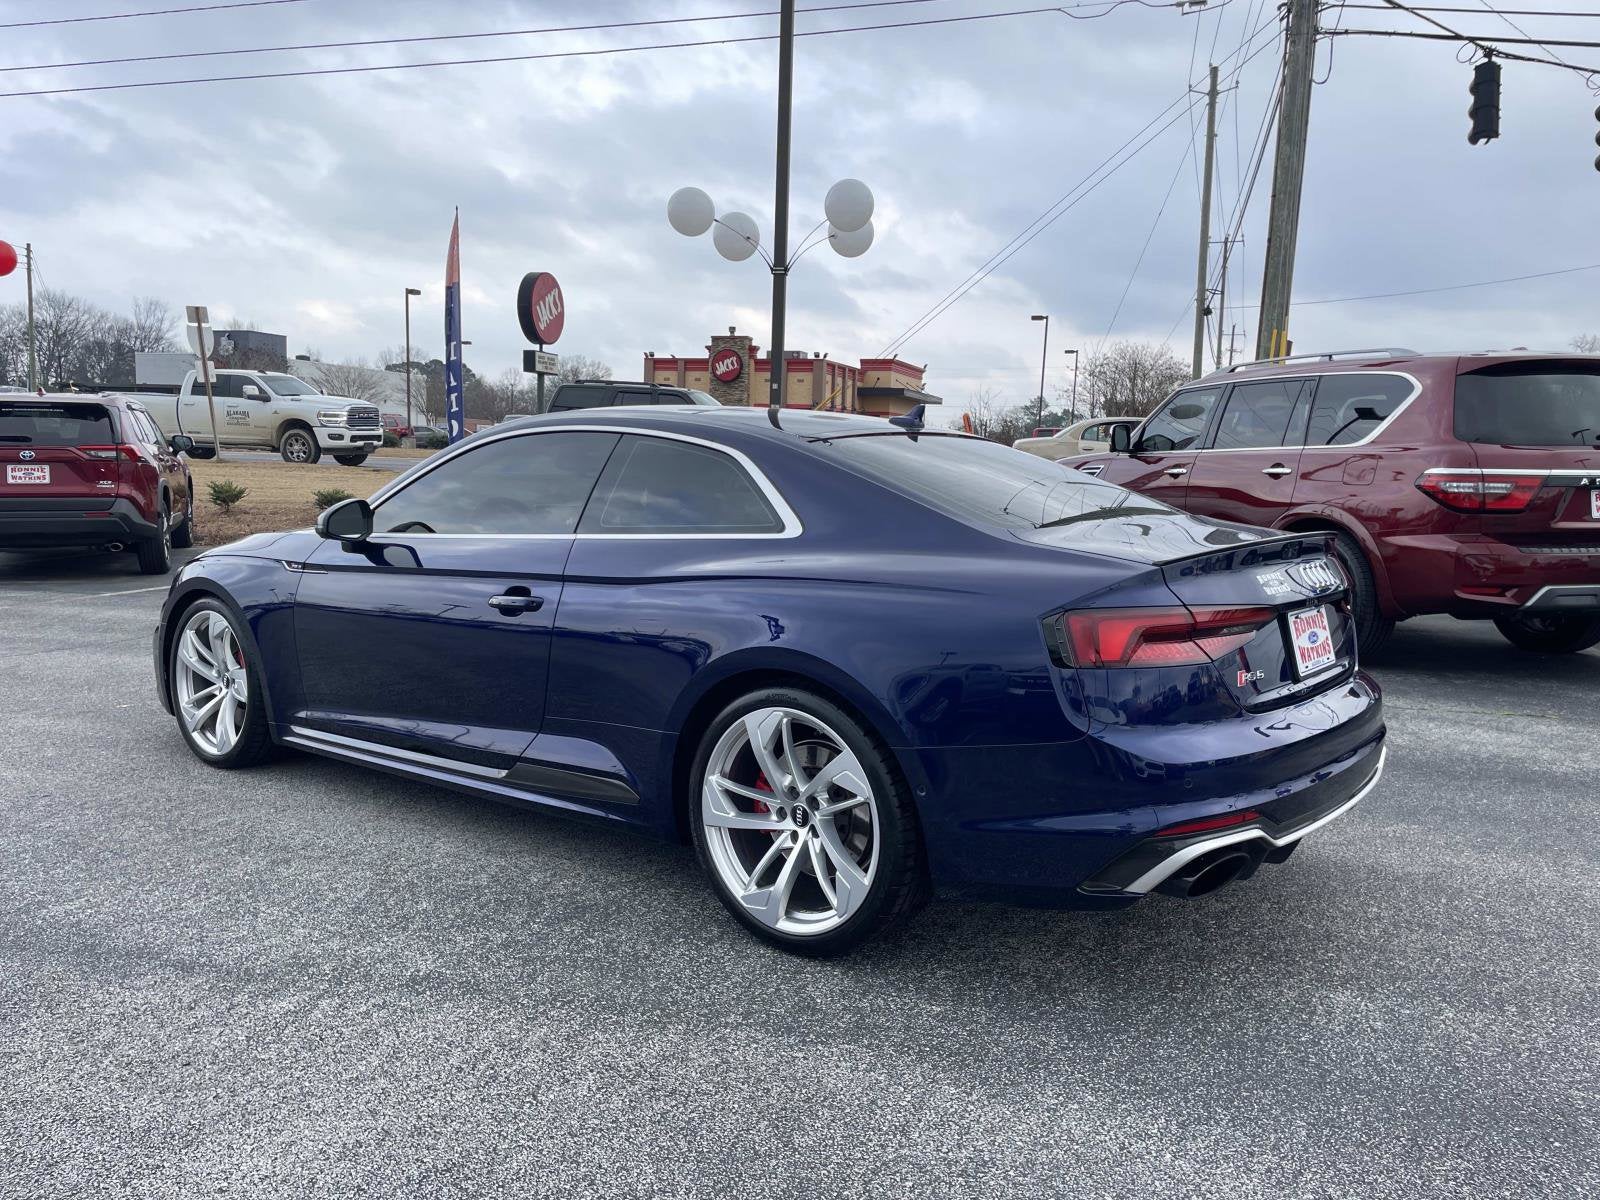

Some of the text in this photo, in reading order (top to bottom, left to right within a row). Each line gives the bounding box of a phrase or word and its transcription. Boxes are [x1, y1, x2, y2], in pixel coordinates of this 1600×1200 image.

[715, 356, 738, 376] JACK'S
[1292, 612, 1328, 639] RONNIE
[1298, 637, 1332, 664] WATKINS
